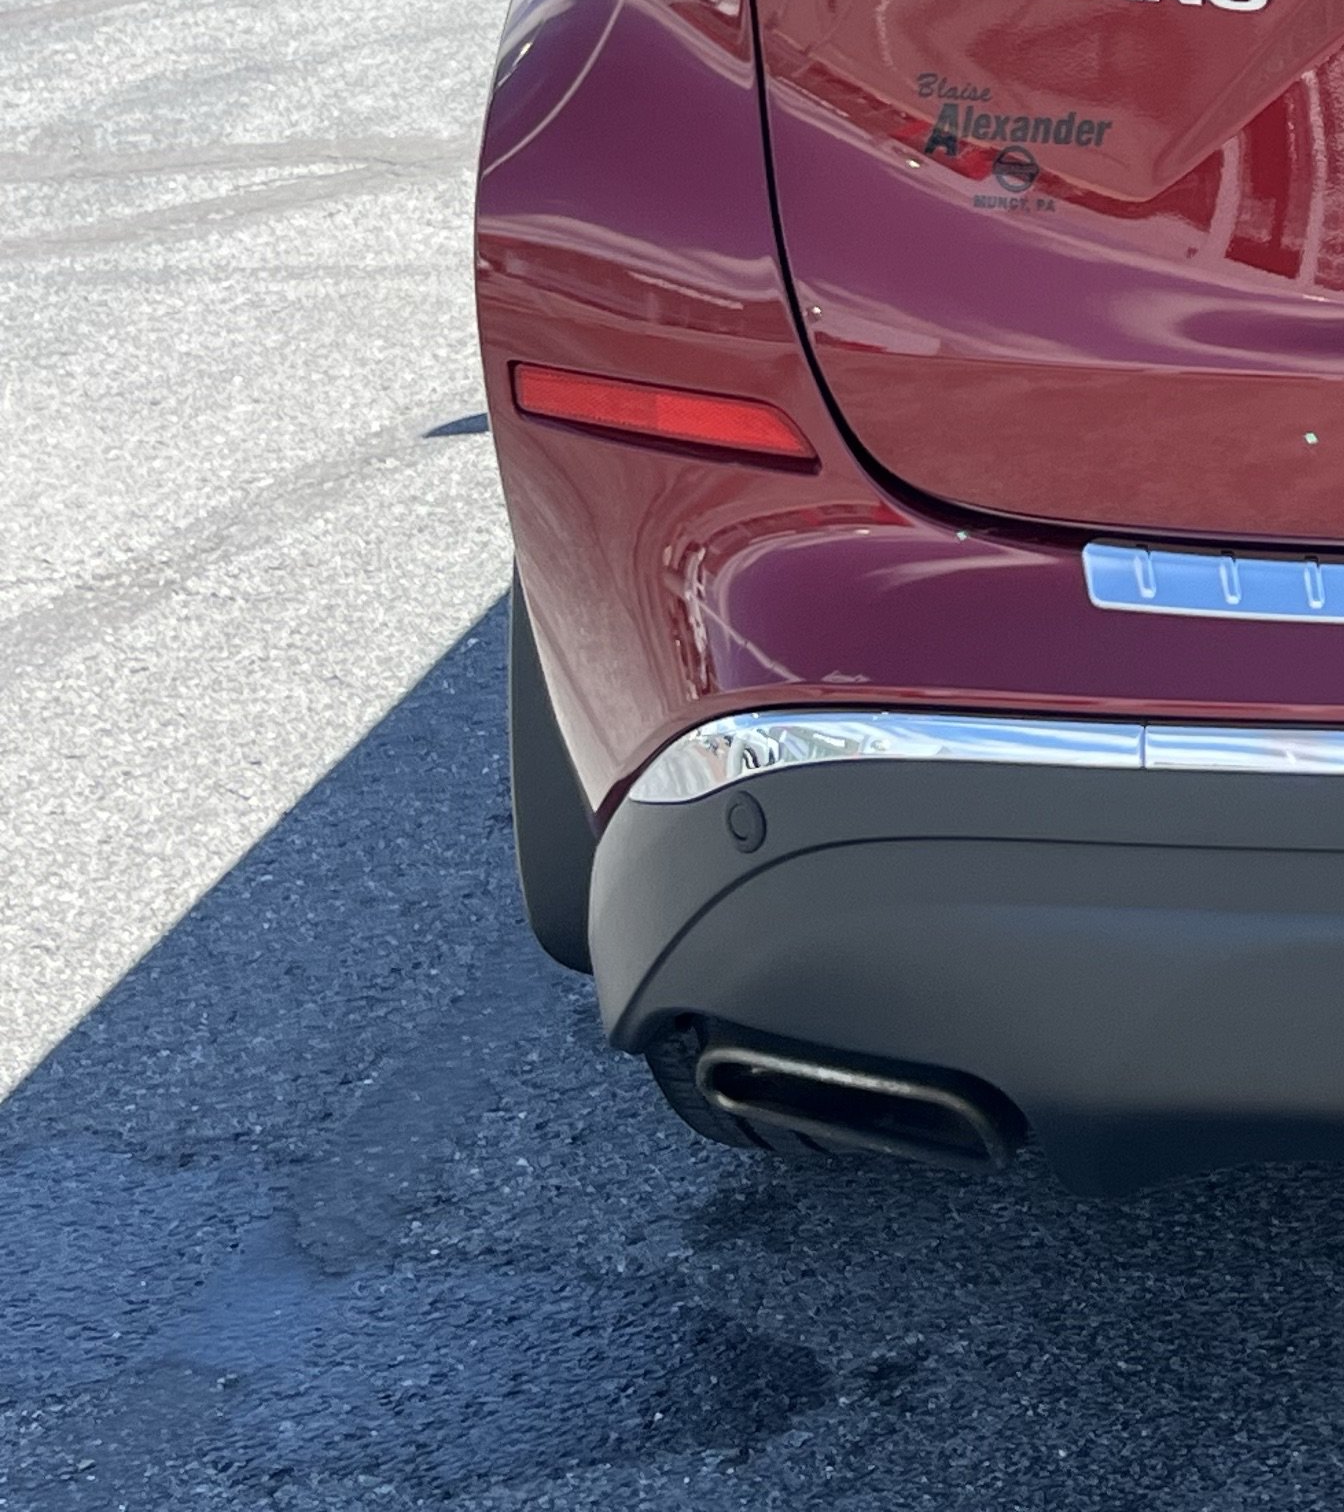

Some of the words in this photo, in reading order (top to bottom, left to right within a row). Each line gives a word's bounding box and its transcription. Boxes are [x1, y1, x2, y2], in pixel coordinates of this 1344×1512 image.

[917, 72, 992, 102] Blaise
[924, 102, 1113, 157] Alexander
[1035, 198, 1056, 212] PA
